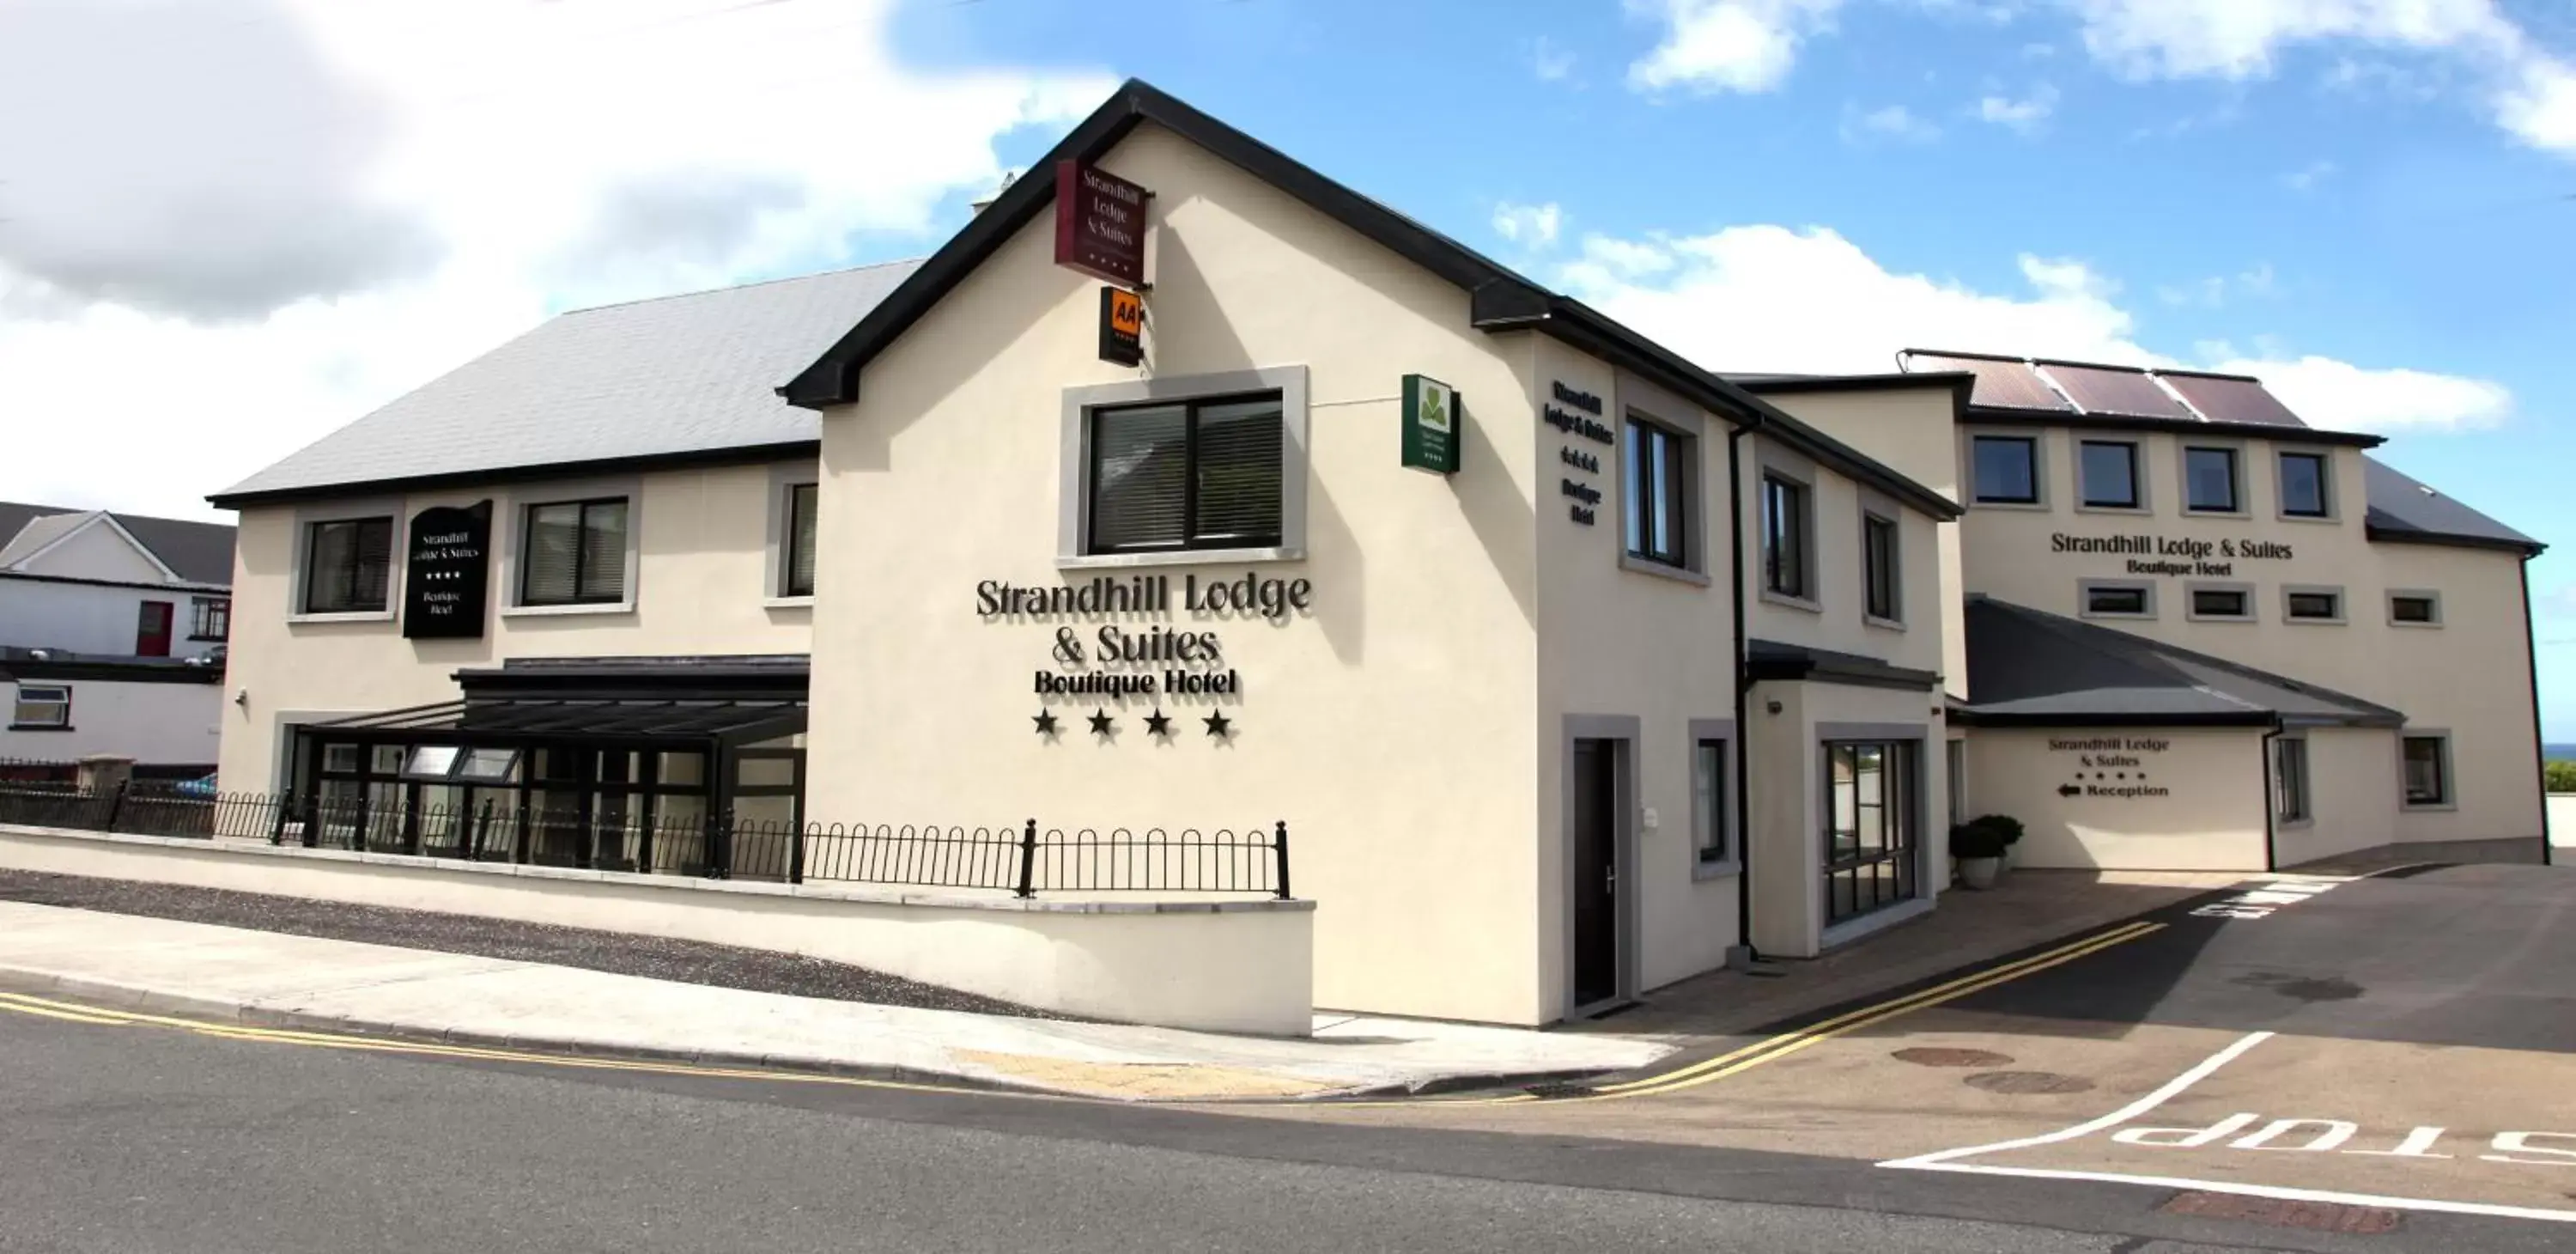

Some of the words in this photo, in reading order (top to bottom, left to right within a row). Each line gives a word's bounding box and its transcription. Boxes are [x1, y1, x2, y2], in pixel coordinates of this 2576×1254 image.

[1116, 301, 1136, 324] AA
[2051, 533, 2151, 555] Strandhill
[2158, 536, 2213, 558] Lodge
[2221, 539, 2235, 557] &
[2240, 539, 2293, 559] Suites
[2127, 560, 2191, 576] Boutique
[2196, 561, 2232, 576] Hotel
[976, 574, 1168, 616] Strandhill
[1185, 572, 1311, 618] Lodge
[1052, 626, 1083, 662] &
[1097, 625, 1220, 662] Suites
[1034, 669, 1156, 699] Boutique
[1164, 669, 1236, 694] Hotel
[2048, 738, 2121, 752] Strandhill
[2126, 739, 2170, 752] Lodge
[2081, 756, 2093, 767] &
[2096, 756, 2141, 767] Suites
[2087, 784, 2170, 798] Reception
[2111, 1111, 2576, 1166] STOP
